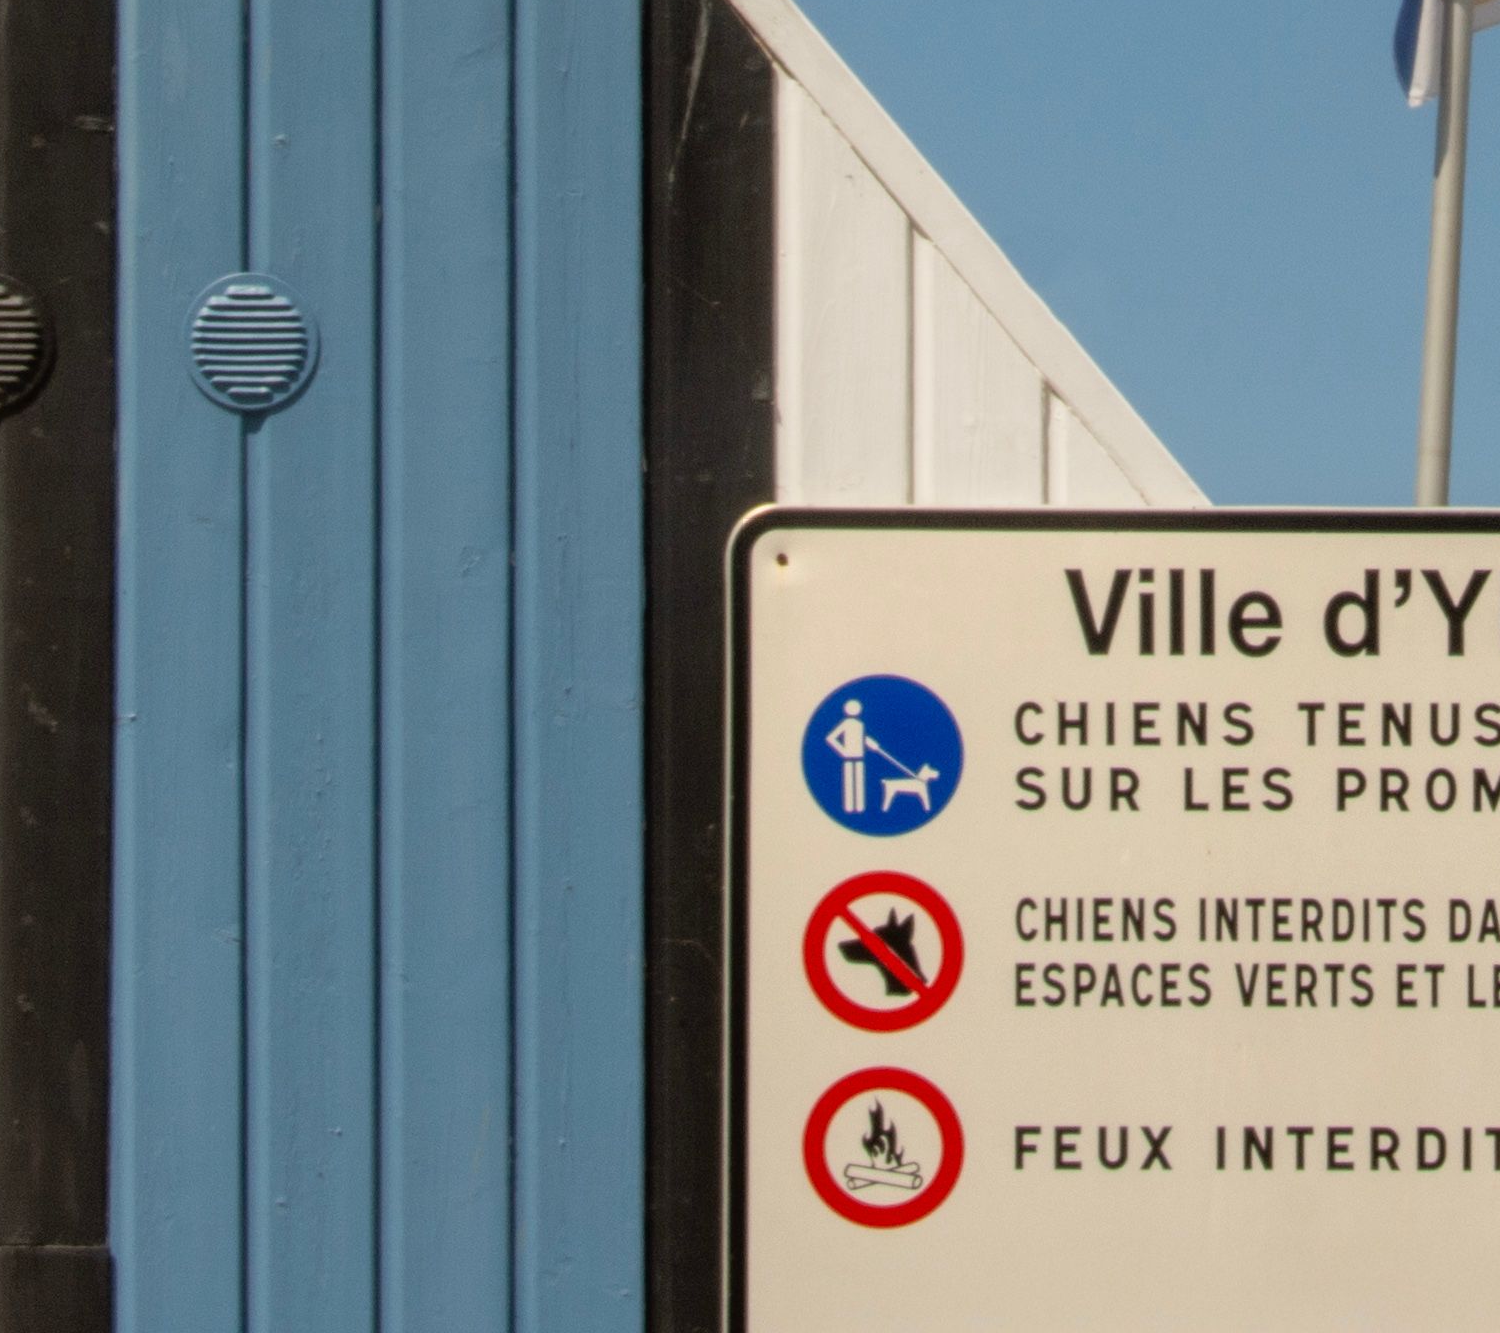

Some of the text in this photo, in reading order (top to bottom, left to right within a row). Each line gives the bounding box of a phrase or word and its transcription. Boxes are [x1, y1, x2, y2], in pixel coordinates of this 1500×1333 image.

[1066, 569, 1283, 658] Ville
[1015, 702, 1254, 746] CHIENS
[1016, 767, 1139, 811] SUR
[1184, 768, 1293, 812] LES
[1015, 898, 1176, 942] CHIENS
[1199, 898, 1426, 942] INTERDITS
[1015, 963, 1211, 1007] ESPACES
[1235, 963, 1374, 1008] VERTS
[1397, 964, 1445, 1008] ET
[1015, 1126, 1171, 1170] FEUX
